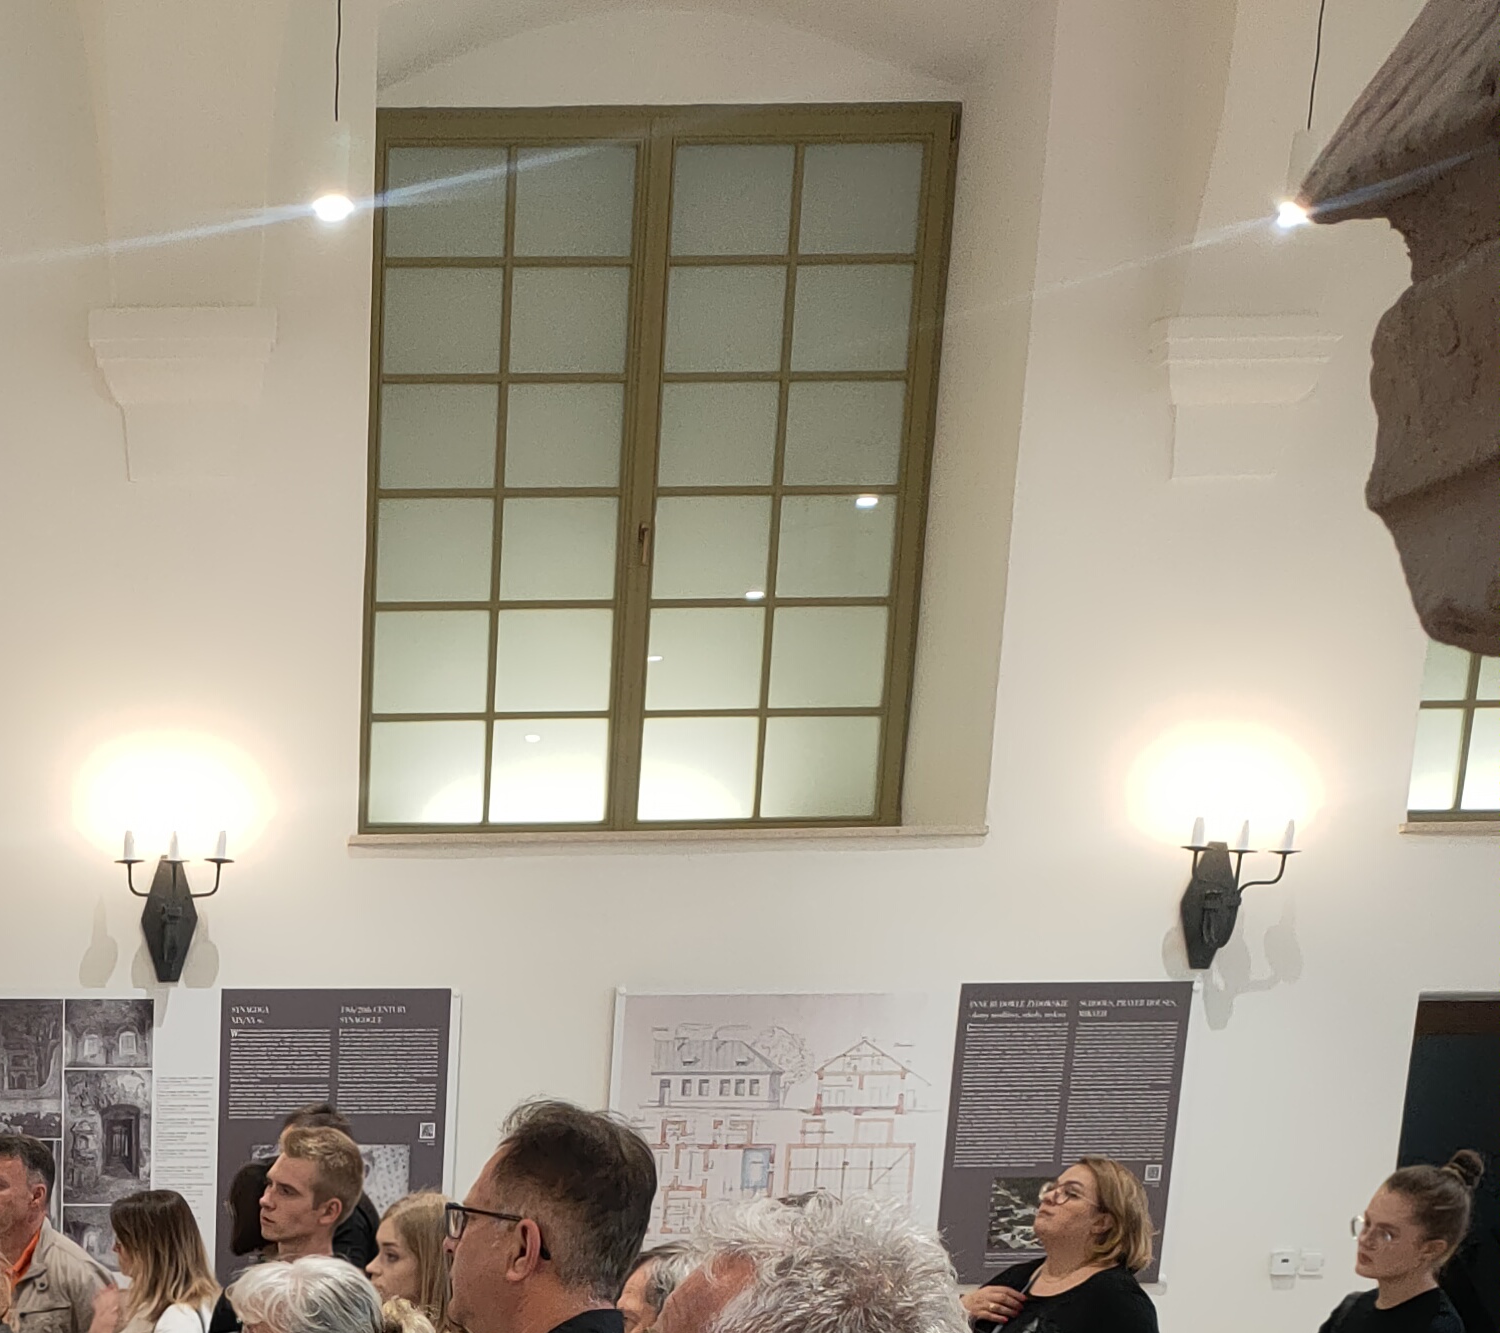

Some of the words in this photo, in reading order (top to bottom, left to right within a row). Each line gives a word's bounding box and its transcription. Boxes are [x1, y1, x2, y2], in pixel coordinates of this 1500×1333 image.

[231, 1005, 269, 1014] SYNAGOGA
[373, 1005, 406, 1013] CENTURY
[339, 1016, 383, 1024] SYNAGOGUE
